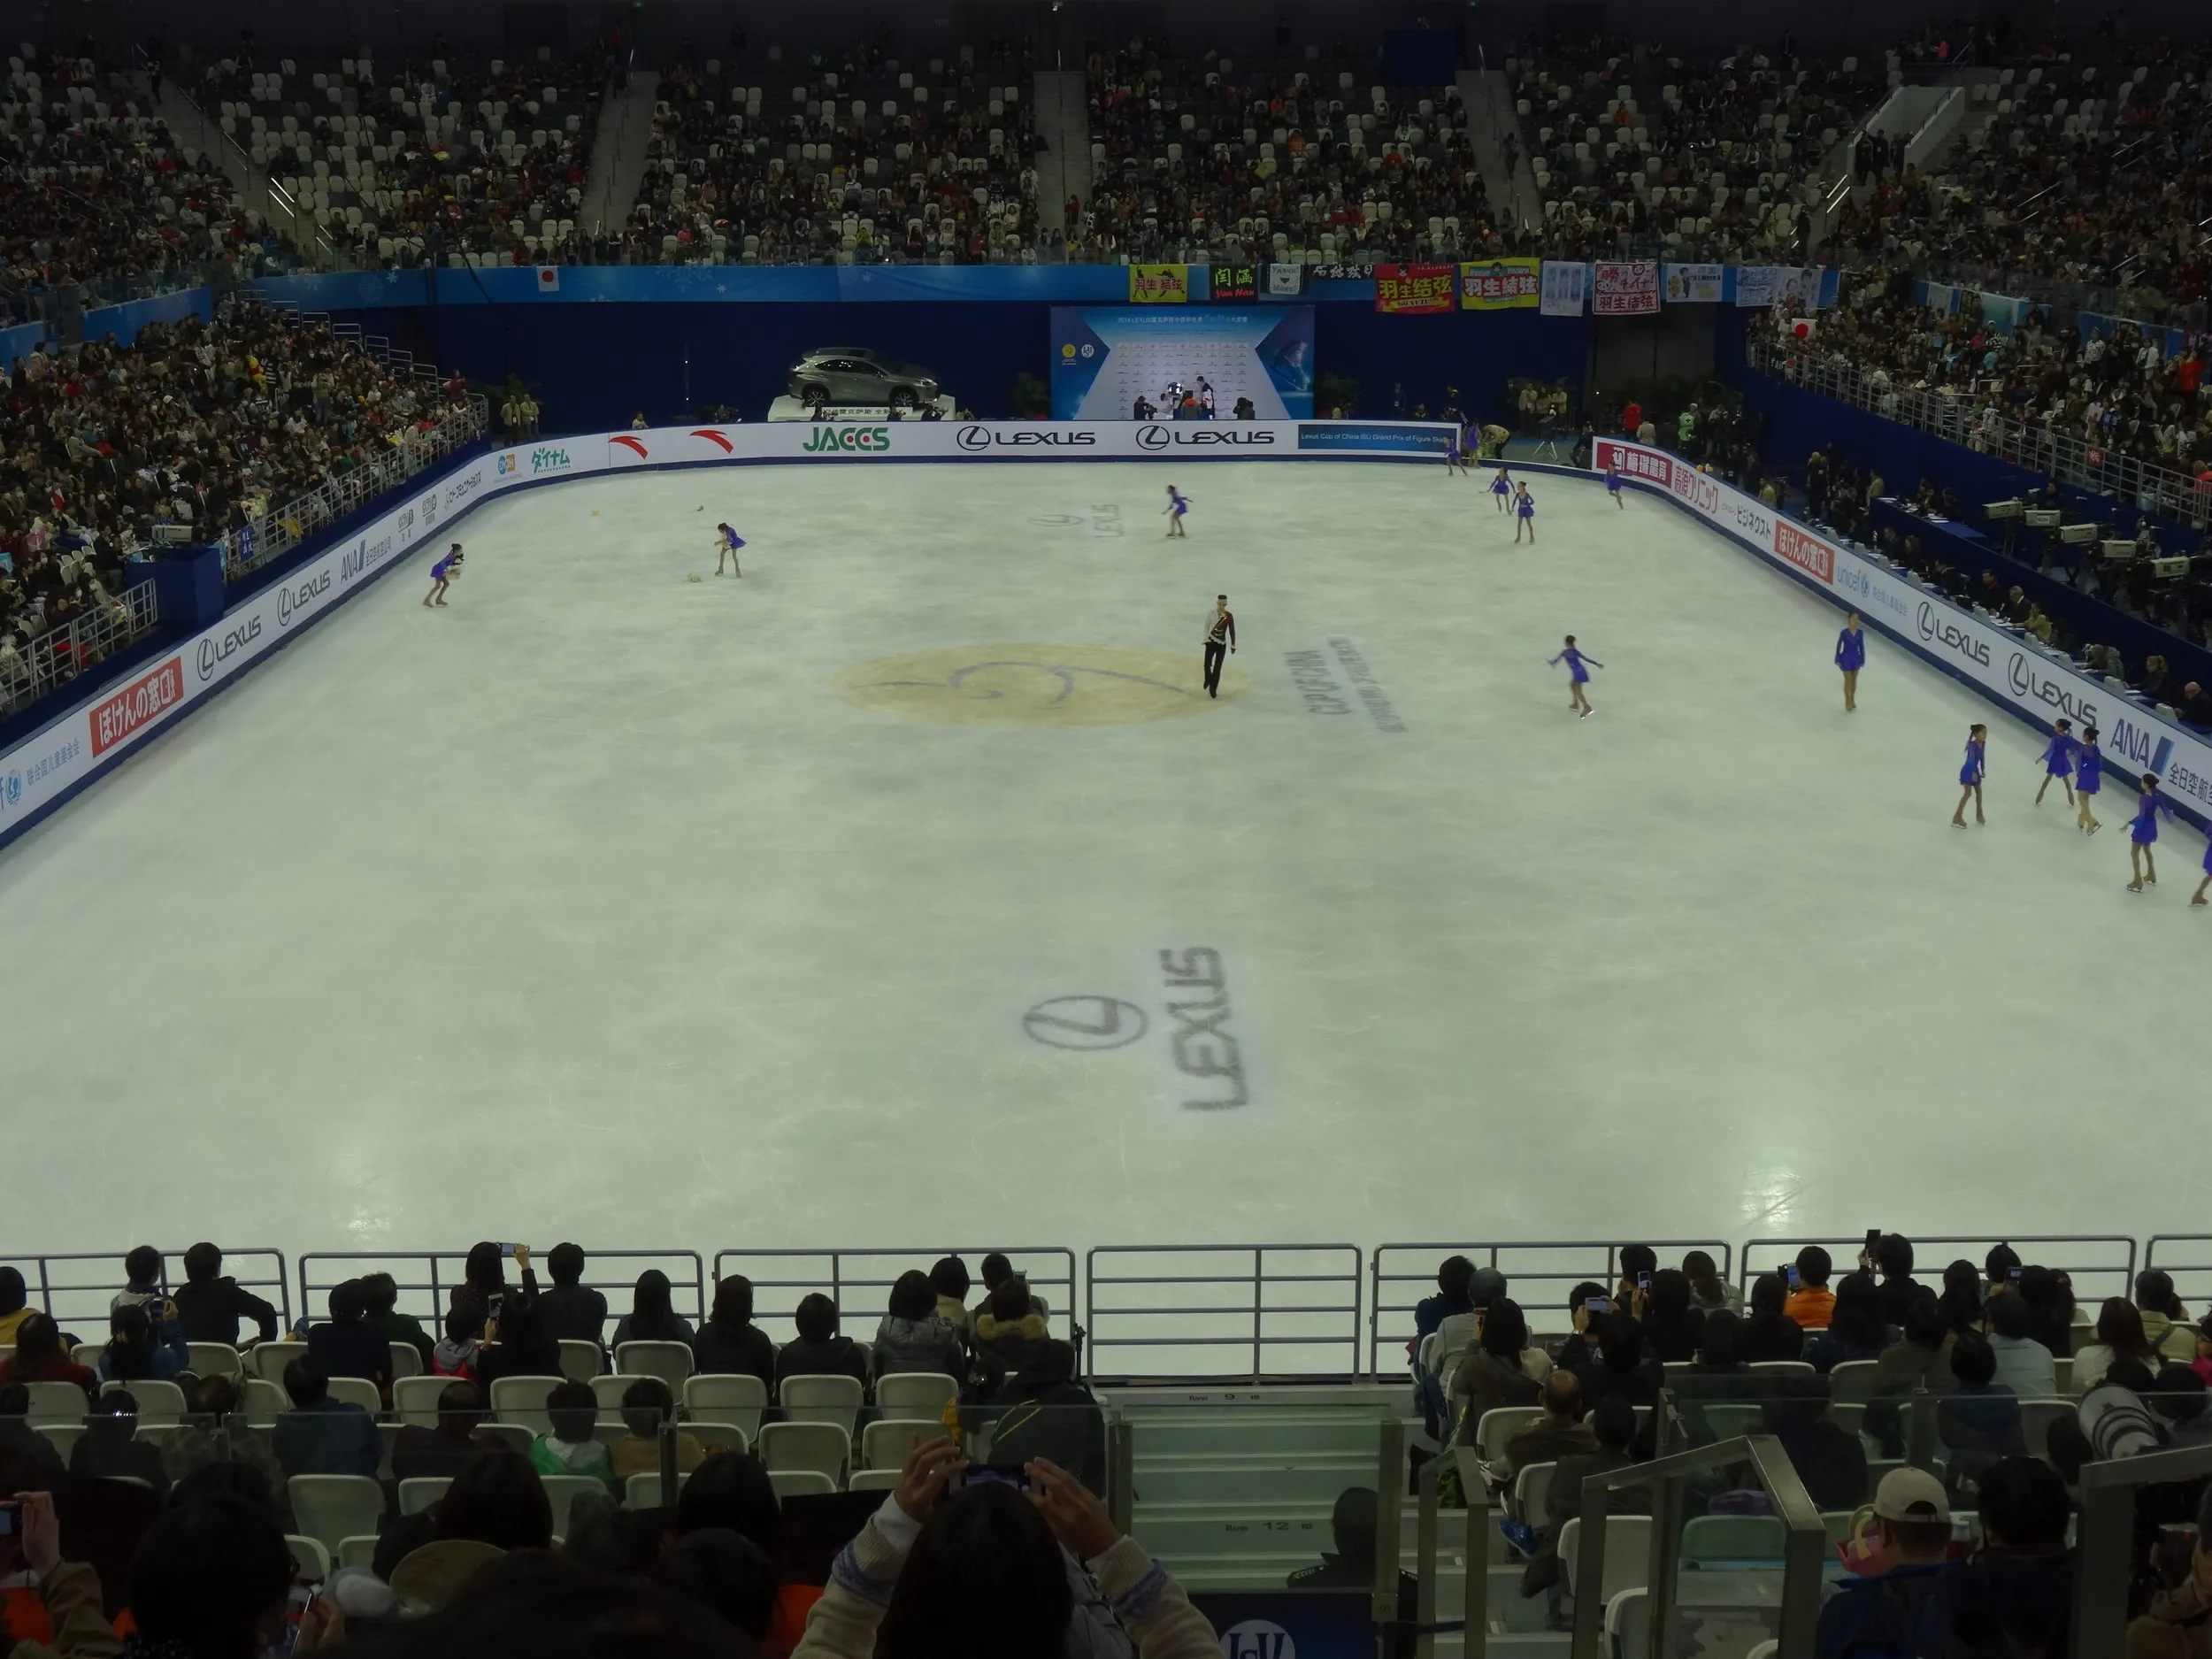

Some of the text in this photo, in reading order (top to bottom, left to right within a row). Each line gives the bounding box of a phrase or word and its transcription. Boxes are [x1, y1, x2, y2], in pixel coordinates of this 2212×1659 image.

[1217, 289, 1233, 299] Yan
[1379, 274, 1453, 299] 羽生结弦
[803, 426, 890, 452] JACCS
[995, 432, 1095, 445] LEXUS
[1174, 431, 1274, 444] LEXUS
[1320, 434, 1333, 442] Cup
[1413, 434, 1431, 444] Figure
[531, 447, 571, 474] ダイナム
[1737, 504, 1771, 541] ビジネクスト
[341, 547, 357, 585] ANA
[1778, 526, 1828, 578] ほけんの窓口
[292, 569, 332, 611] LEXUS
[1837, 565, 1862, 592] unicef
[215, 614, 262, 662] LEXUS
[1935, 618, 1990, 668] LEXUS
[98, 669, 175, 747] ほけんの窓口
[2031, 671, 2098, 731] LEXUS
[2109, 718, 2151, 770] ANA
[1158, 947, 1248, 1112] LEXUS
[1262, 1521, 1290, 1531] 12
